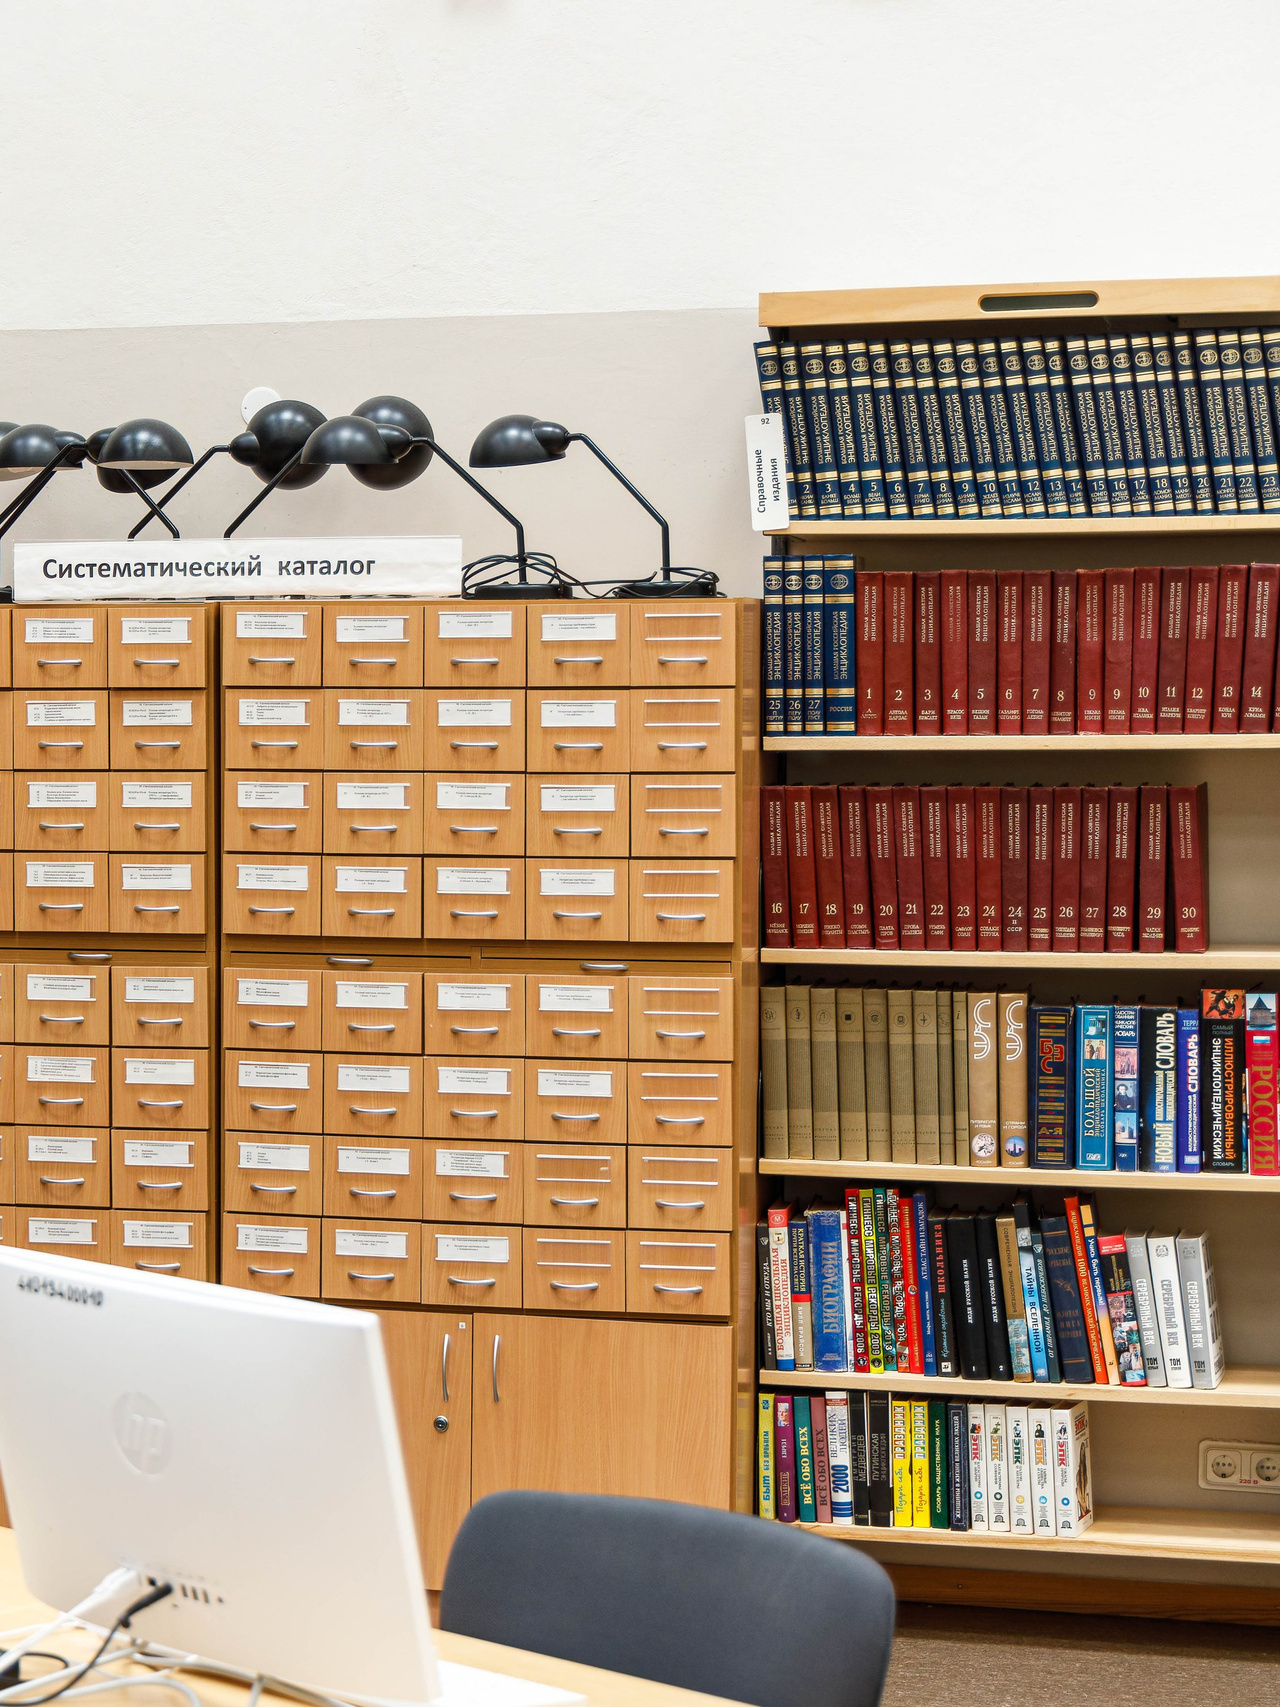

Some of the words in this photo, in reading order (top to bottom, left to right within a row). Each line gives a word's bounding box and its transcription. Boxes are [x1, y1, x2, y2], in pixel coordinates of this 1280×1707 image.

[864, 394, 877, 461] ЭНЦИКЛОПЕДИЯ
[1257, 386, 1273, 456] ЭНЦИКЛОПЕДИЯ
[755, 449, 766, 513] Справочные
[770, 458, 781, 501] издания
[871, 482, 877, 491] 5
[983, 482, 996, 492] 10
[1113, 480, 1126, 490] 16
[1263, 477, 1276, 486] 23
[43, 555, 262, 578] Систематический
[278, 558, 375, 575] каталог
[840, 611, 848, 679] ЭНЦИКЛОПЕДИЯ
[769, 701, 781, 709] 25
[867, 689, 871, 698] 1
[977, 688, 984, 699] 5
[1138, 687, 1149, 698] 10
[772, 903, 782, 914] 16
[957, 906, 970, 916] 23
[1033, 907, 1047, 918] 25
[1086, 907, 1099, 918] 27
[1112, 906, 1127, 917] 28
[1182, 907, 1196, 918] 30
[1156, 1012, 1175, 1069] СЛОВАРЬ
[1187, 1034, 1198, 1093] СЛОВАРЬ
[1084, 1068, 1095, 1137] БОЛЬШОЙ
[1154, 1070, 1164, 1121] ИЛЛЮСТРИРОВАННЫЙ
[1165, 1070, 1175, 1121] ЭНЦИКЛОПЕДИЧЕСКИЙ
[1212, 1037, 1224, 1159] ЭНЦИКЛОПЕДИЧЕСКИЙ
[1224, 1037, 1236, 1159] ИЛЛЮСТРИРОВАННЫЙ
[1038, 1126, 1063, 1135] А-Я
[1252, 1064, 1275, 1170] РОССИЯ
[1154, 1122, 1174, 1163] НОВЫЙ
[847, 1196, 860, 1235] ГИННЕСС
[862, 1197, 875, 1236] ГИННЕСС
[875, 1194, 887, 1233] ГИННЕСС
[888, 1195, 899, 1233] ГИННЕСС
[917, 1202, 925, 1231] ЗАГАДОК
[797, 1228, 805, 1258] КРАТКАЯ
[1071, 1210, 1083, 1257] ЭНЦИКЛОПЕДИЯ
[1088, 1238, 1096, 1258] Учись
[850, 1238, 862, 1283] МИРОВЫЕ
[865, 1240, 877, 1284] МИРОВЫЕ
[878, 1236, 889, 1280] МИРОВЫЕ
[891, 1235, 902, 1278] МИРОВЫЕ
[920, 1258, 928, 1280] АТЛАС
[1003, 1227, 1012, 1267] СОВРЕМЕННАЯ
[1008, 1270, 1017, 1313] ЭНЦИКЛОПЕДИЯ
[1078, 1258, 1087, 1277] 1000
[1091, 1258, 1099, 1276] быть
[771, 1247, 781, 1302] ШКОЛЬНАЯ
[798, 1259, 806, 1292] ИСТОРИЯ
[821, 1241, 839, 1333] БИОГРАФИИ
[1024, 1267, 1035, 1297] ТАЙНЫ
[765, 1298, 771, 1311] МЫ
[780, 1258, 791, 1337] ЭНЦИКЛОПЕДИЯ
[852, 1286, 864, 1328] РЕКОРДЫ
[880, 1284, 891, 1326] РЕКОРДЫ
[893, 1280, 905, 1320] РЕКОРДЫ
[1082, 1279, 1090, 1306] ВЕЛИКИХ
[1135, 1278, 1154, 1330] СЕРЕБРЯНЫЙ
[1160, 1279, 1178, 1329] СЕРЕБРЯНЫЙ
[1186, 1281, 1203, 1331] СЕРЕБРЯНЫЙ
[867, 1287, 879, 1330] РЕКОРДЫ
[1085, 1307, 1095, 1329] ЛЮДЕЙ
[774, 1304, 784, 1351] БОЛЬШАЯ
[883, 1329, 892, 1351] 2013
[897, 1322, 905, 1342] 2014
[1029, 1301, 1043, 1353] ВСЕЛЕННОЙ
[1142, 1330, 1155, 1346] ВЕК
[1167, 1331, 1179, 1346] ВЕК
[1191, 1333, 1204, 1348] ВЕК
[856, 1332, 866, 1354] 2008
[870, 1333, 880, 1355] 2009
[1089, 1330, 1101, 1372] ТЫСЯЧЕЛЕТИЯ
[1146, 1357, 1158, 1366] ТОМ
[1170, 1358, 1181, 1366] ТОМ
[1194, 1360, 1206, 1369] ТОМ
[799, 1427, 809, 1455] ВСЕХ
[816, 1429, 825, 1457] ВСЕХ
[828, 1413, 838, 1458] ВЕЛИКИХ
[837, 1418, 847, 1453] ЛЮДЕЙ
[894, 1405, 906, 1459] ПРАЗДНИК
[914, 1405, 926, 1459] ПРАЗДНИК
[857, 1435, 866, 1481] МЕДВЕДЕВ
[871, 1433, 879, 1480] ПУТИНСКАЯ
[879, 1433, 887, 1481] ЭНЦИКЛОПЕДИЯ
[971, 1436, 979, 1460] ЭПК
[1035, 1440, 1044, 1465] ЭПК
[801, 1458, 810, 1480] ОБО
[818, 1460, 826, 1482] ОБО
[831, 1465, 849, 1493] 2000
[894, 1466, 903, 1482] себе
[914, 1466, 923, 1482] себе
[801, 1483, 812, 1504] ВСЁ
[817, 1485, 828, 1506] ВСЁ
[896, 1483, 907, 1513] Подари
[916, 1483, 927, 1513] Подари
